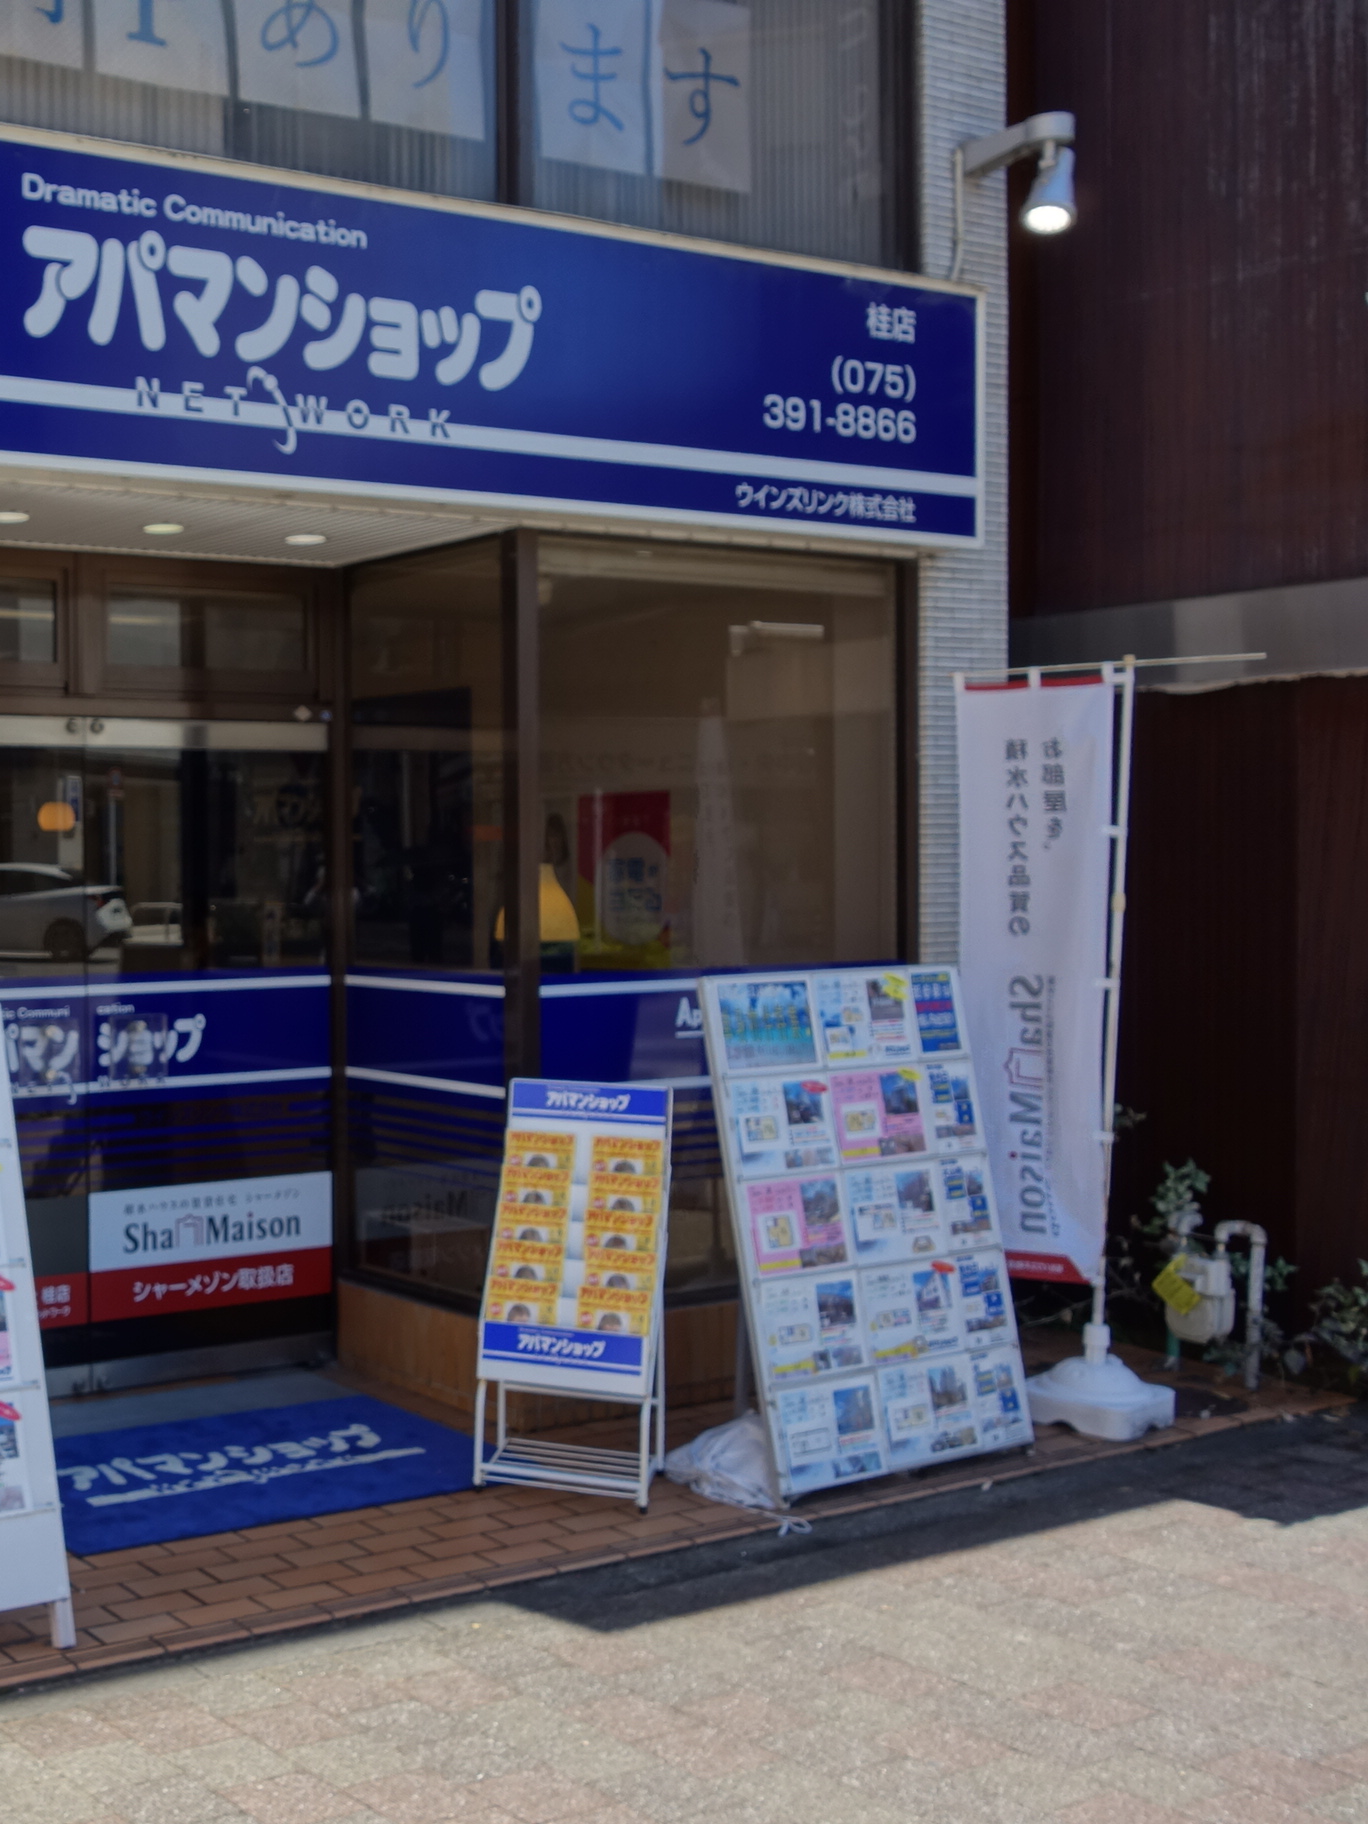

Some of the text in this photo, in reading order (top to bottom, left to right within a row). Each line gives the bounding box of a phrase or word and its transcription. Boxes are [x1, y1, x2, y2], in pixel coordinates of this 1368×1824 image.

[20, 172, 369, 251] Dramatic Communication
[21, 223, 543, 392] アパマンショップ
[866, 301, 917, 344] 桂店
[831, 354, 918, 402] (075)
[762, 393, 918, 444] 391-8866
